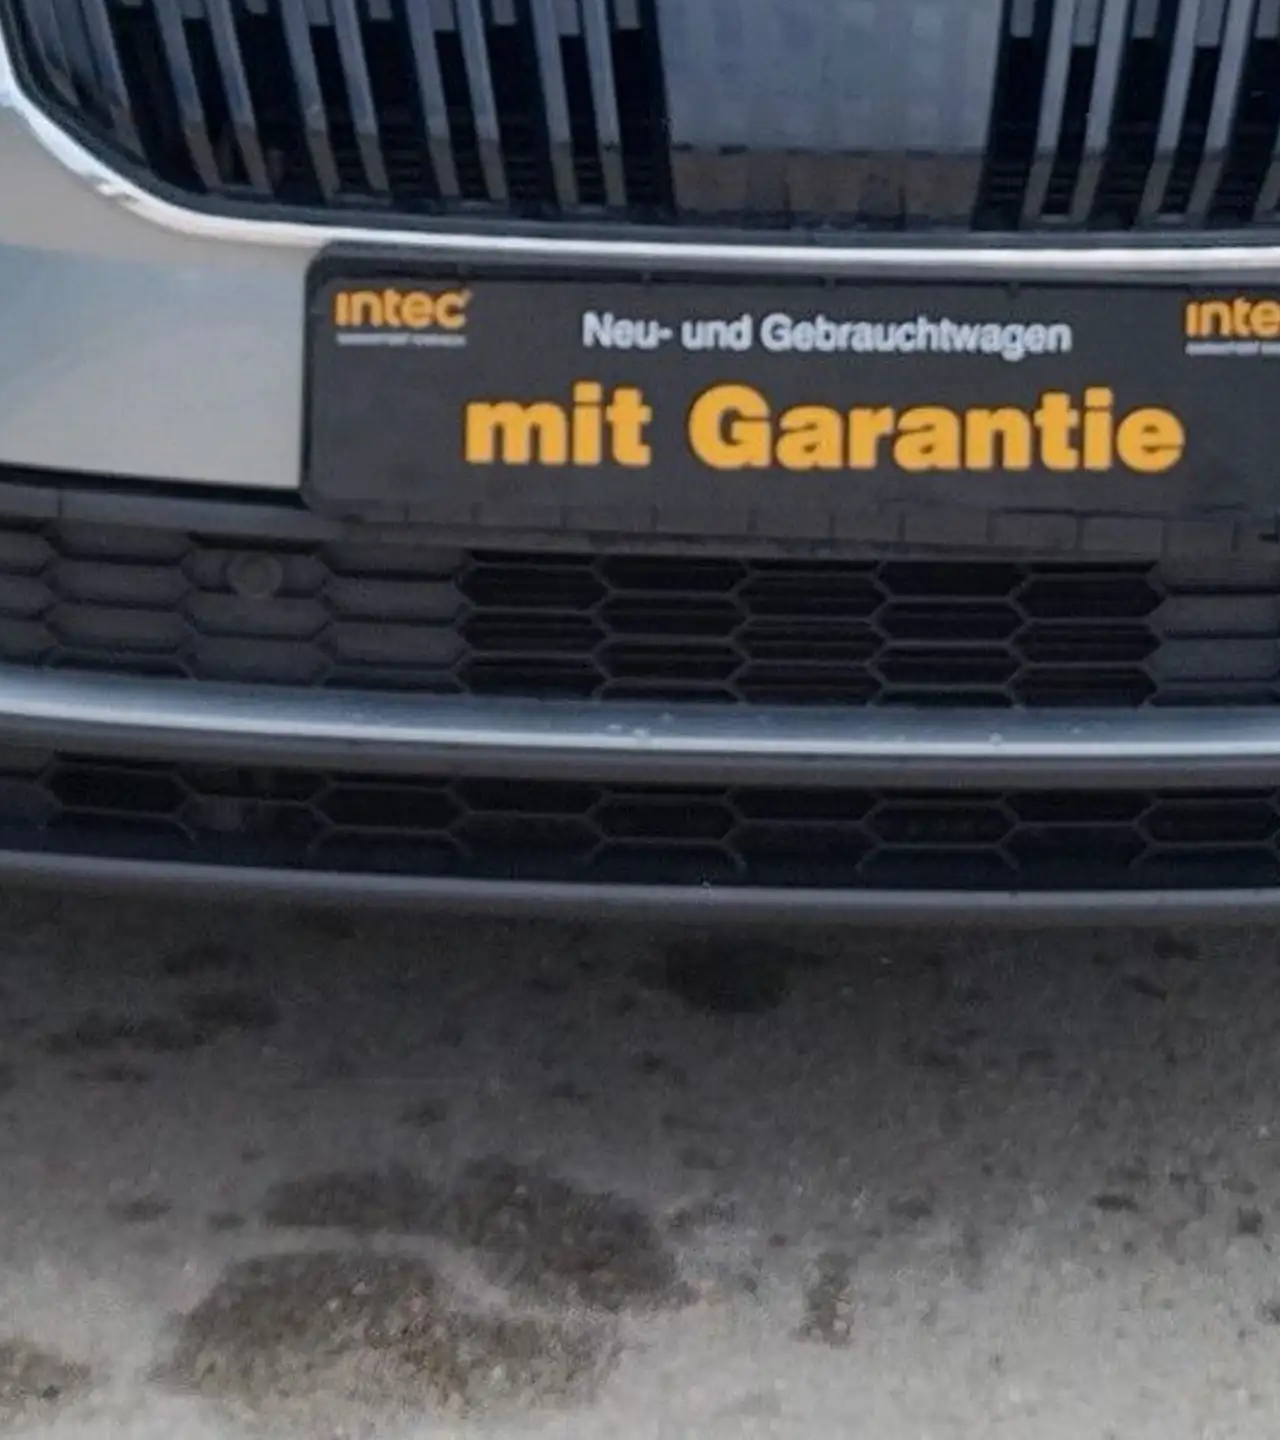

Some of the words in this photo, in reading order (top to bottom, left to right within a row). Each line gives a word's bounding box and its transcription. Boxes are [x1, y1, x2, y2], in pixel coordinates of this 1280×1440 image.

[335, 288, 470, 329] intec
[582, 310, 673, 349] Neu-
[681, 312, 753, 350] und
[760, 312, 1073, 361] Gebrauchtwagen
[465, 382, 652, 467] mit
[688, 384, 1186, 473] Garantie
